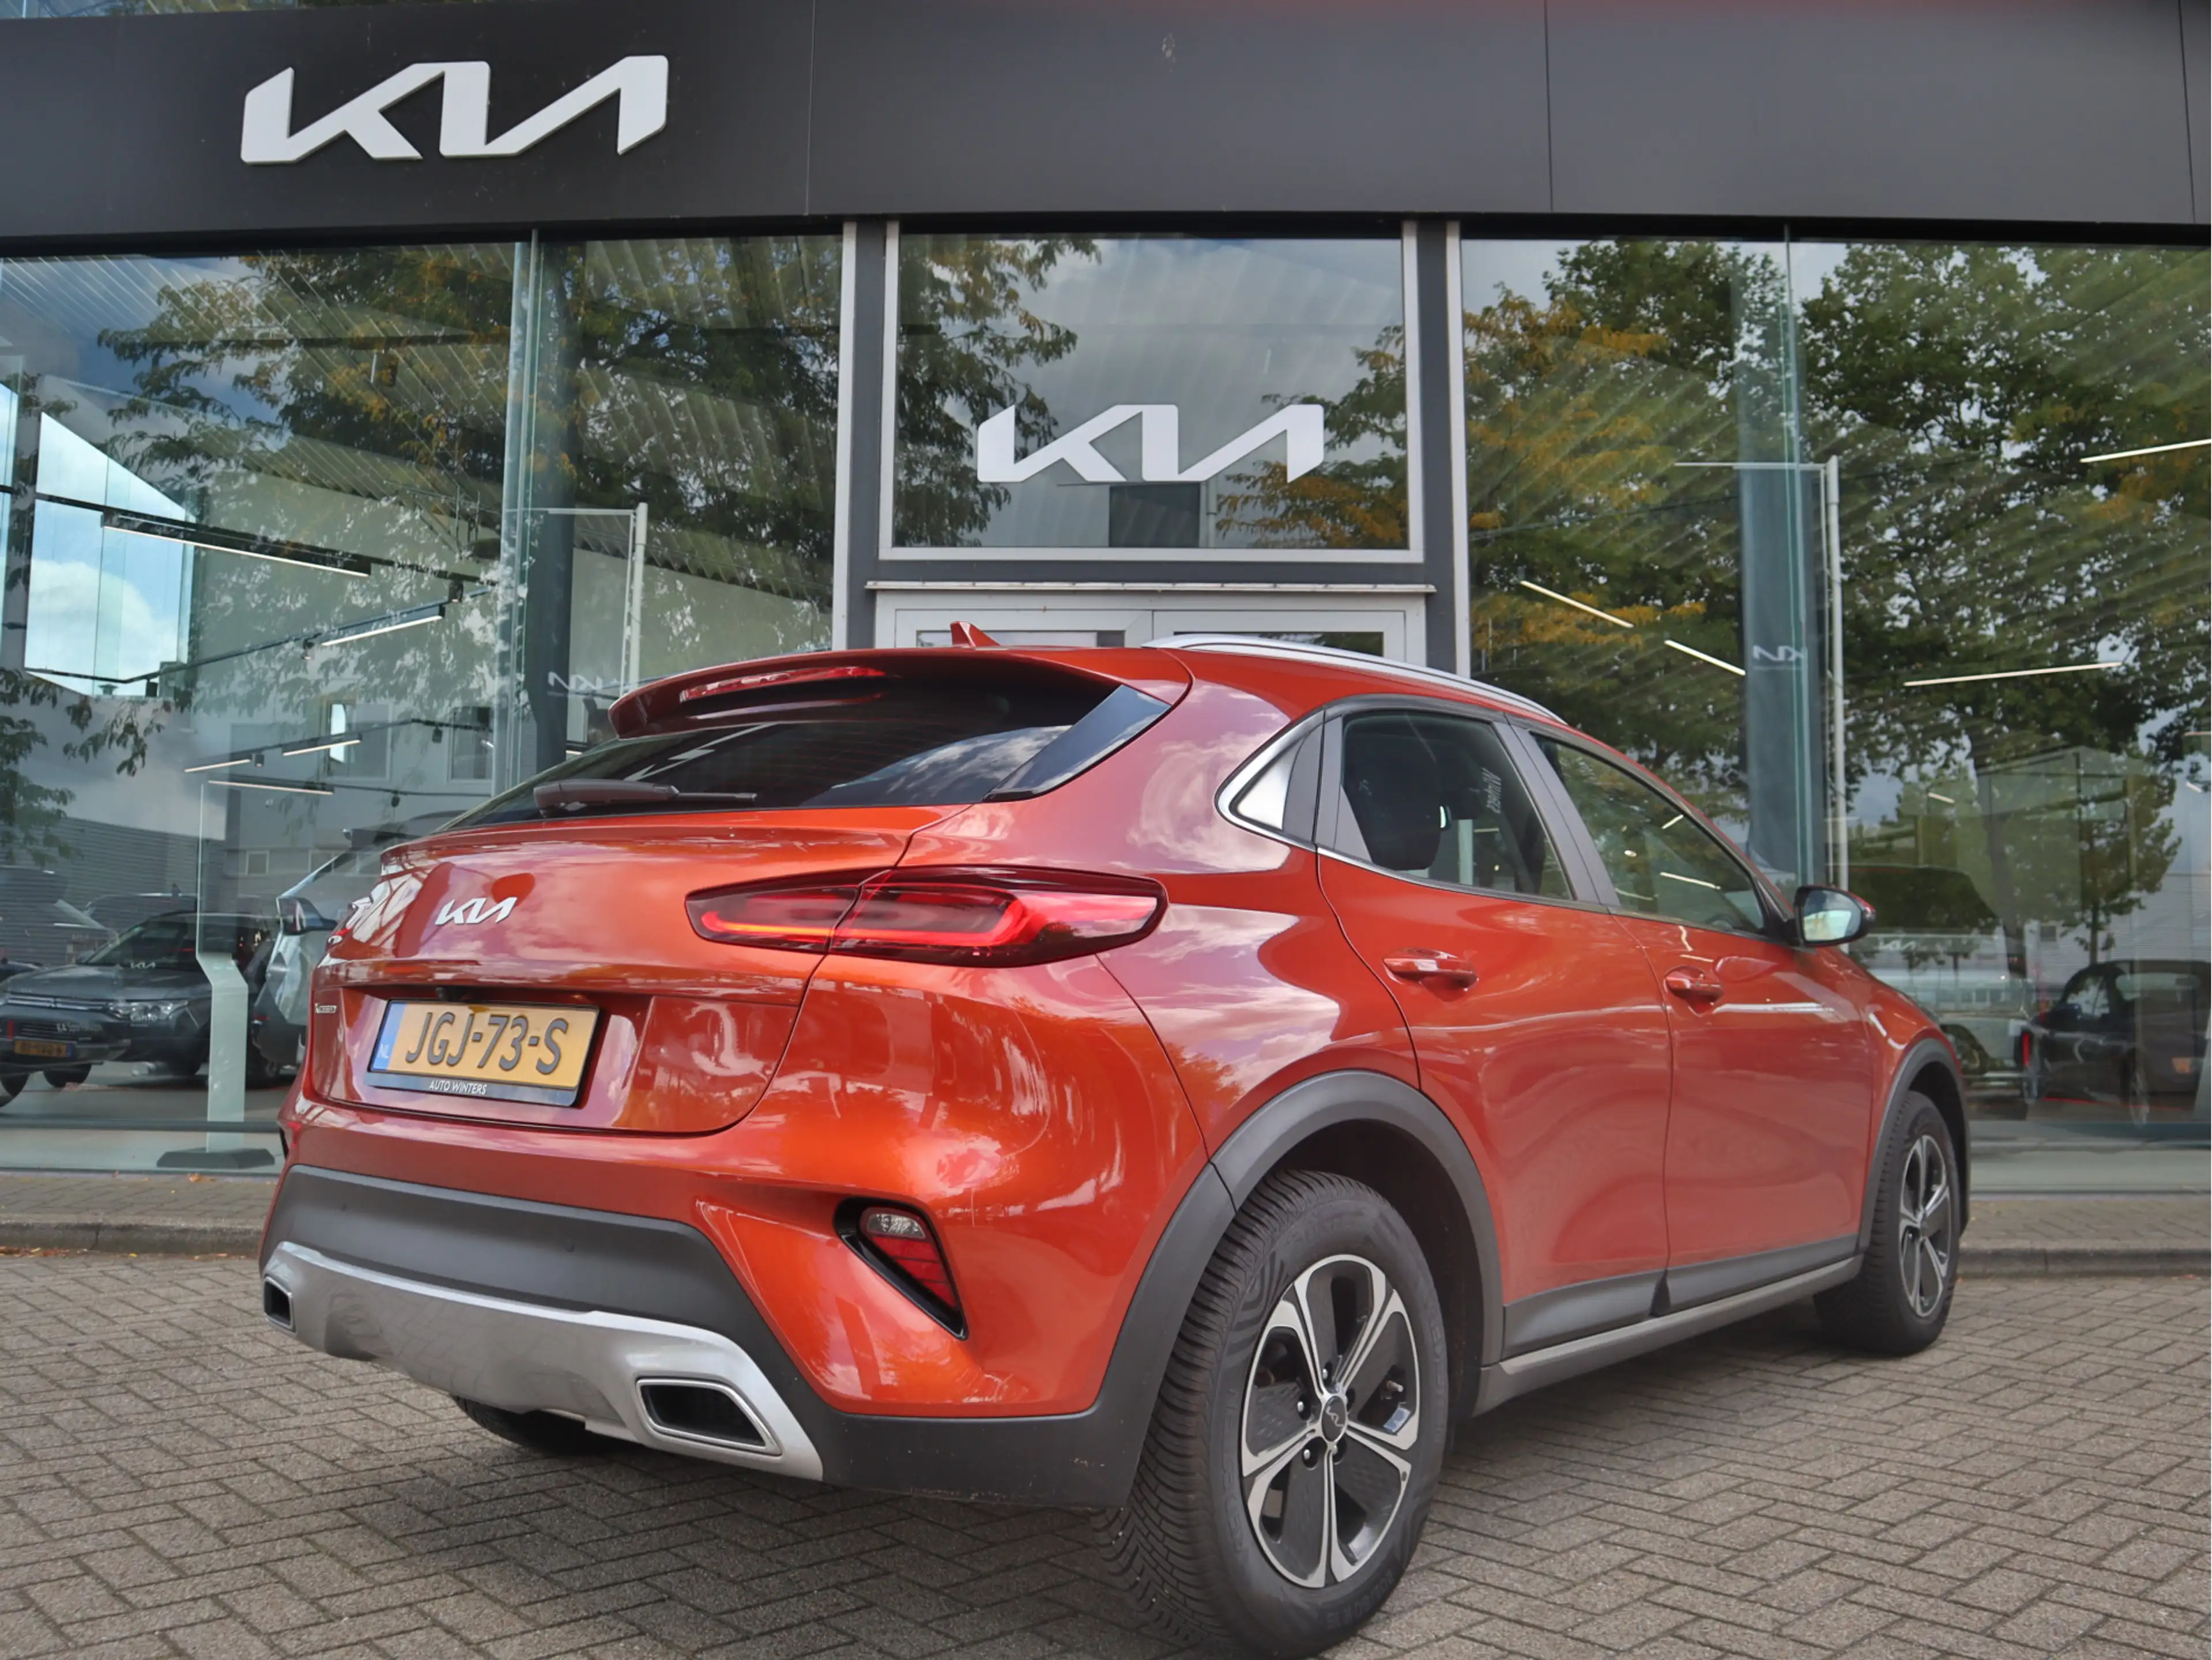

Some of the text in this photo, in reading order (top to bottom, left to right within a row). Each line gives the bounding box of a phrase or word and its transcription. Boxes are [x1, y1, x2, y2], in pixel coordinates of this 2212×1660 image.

[240, 55, 669, 165] KIA
[977, 404, 1325, 482] KIA
[434, 896, 518, 925] KIA
[378, 1043, 390, 1059] NL
[405, 1012, 568, 1074] JGJ-73-S
[428, 1079, 487, 1095] AUTO WINTERS
